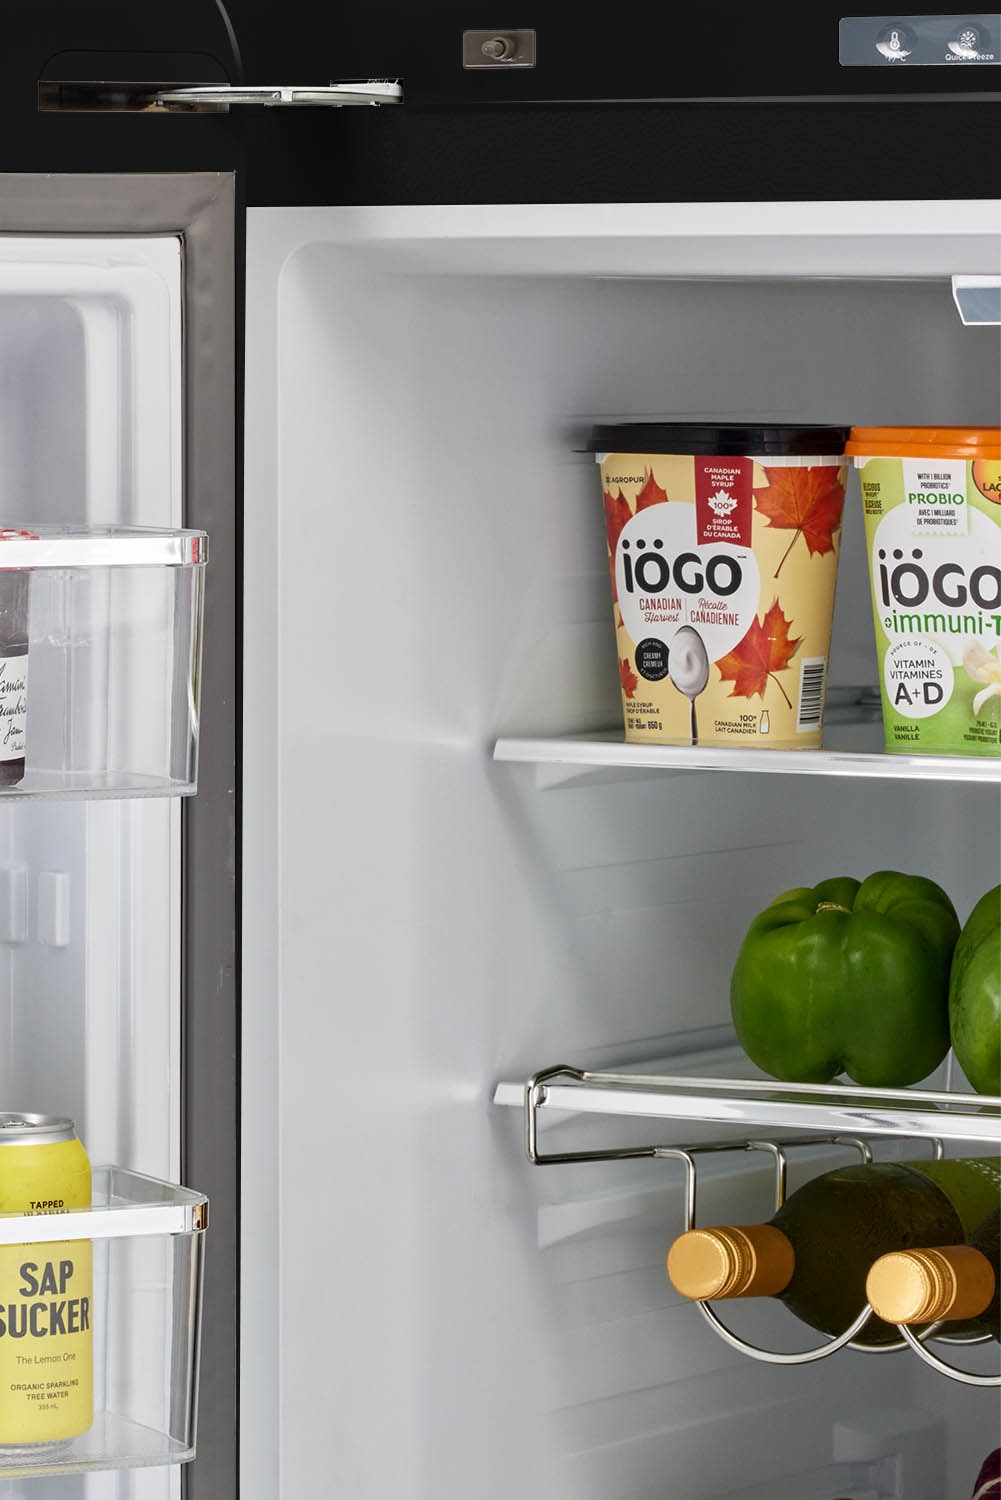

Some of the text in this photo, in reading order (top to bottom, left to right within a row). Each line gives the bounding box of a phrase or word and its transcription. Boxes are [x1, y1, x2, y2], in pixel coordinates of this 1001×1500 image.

[704, 467, 741, 475] CANADIAN
[611, 476, 645, 484] AGROPUR
[908, 493, 964, 505] PROBIO
[706, 524, 738, 532] D'ÉRABLE
[713, 531, 741, 539] CANADA
[639, 598, 682, 611] CANADIAN
[644, 611, 680, 623] Harvest
[690, 610, 740, 626] CANADIENNE
[893, 659, 935, 669] VITAMIN
[890, 670, 943, 679] VITAMINES
[894, 682, 944, 705] A+D
[714, 720, 742, 728] CANADIAN
[29, 1199, 65, 1210] TAPPED
[18, 1259, 74, 1298] SAP
[15, 1352, 76, 1366] The Lemon One
[10, 1379, 79, 1392] ORGANIC SPARKLING
[26, 1390, 69, 1401] TREE WATER
